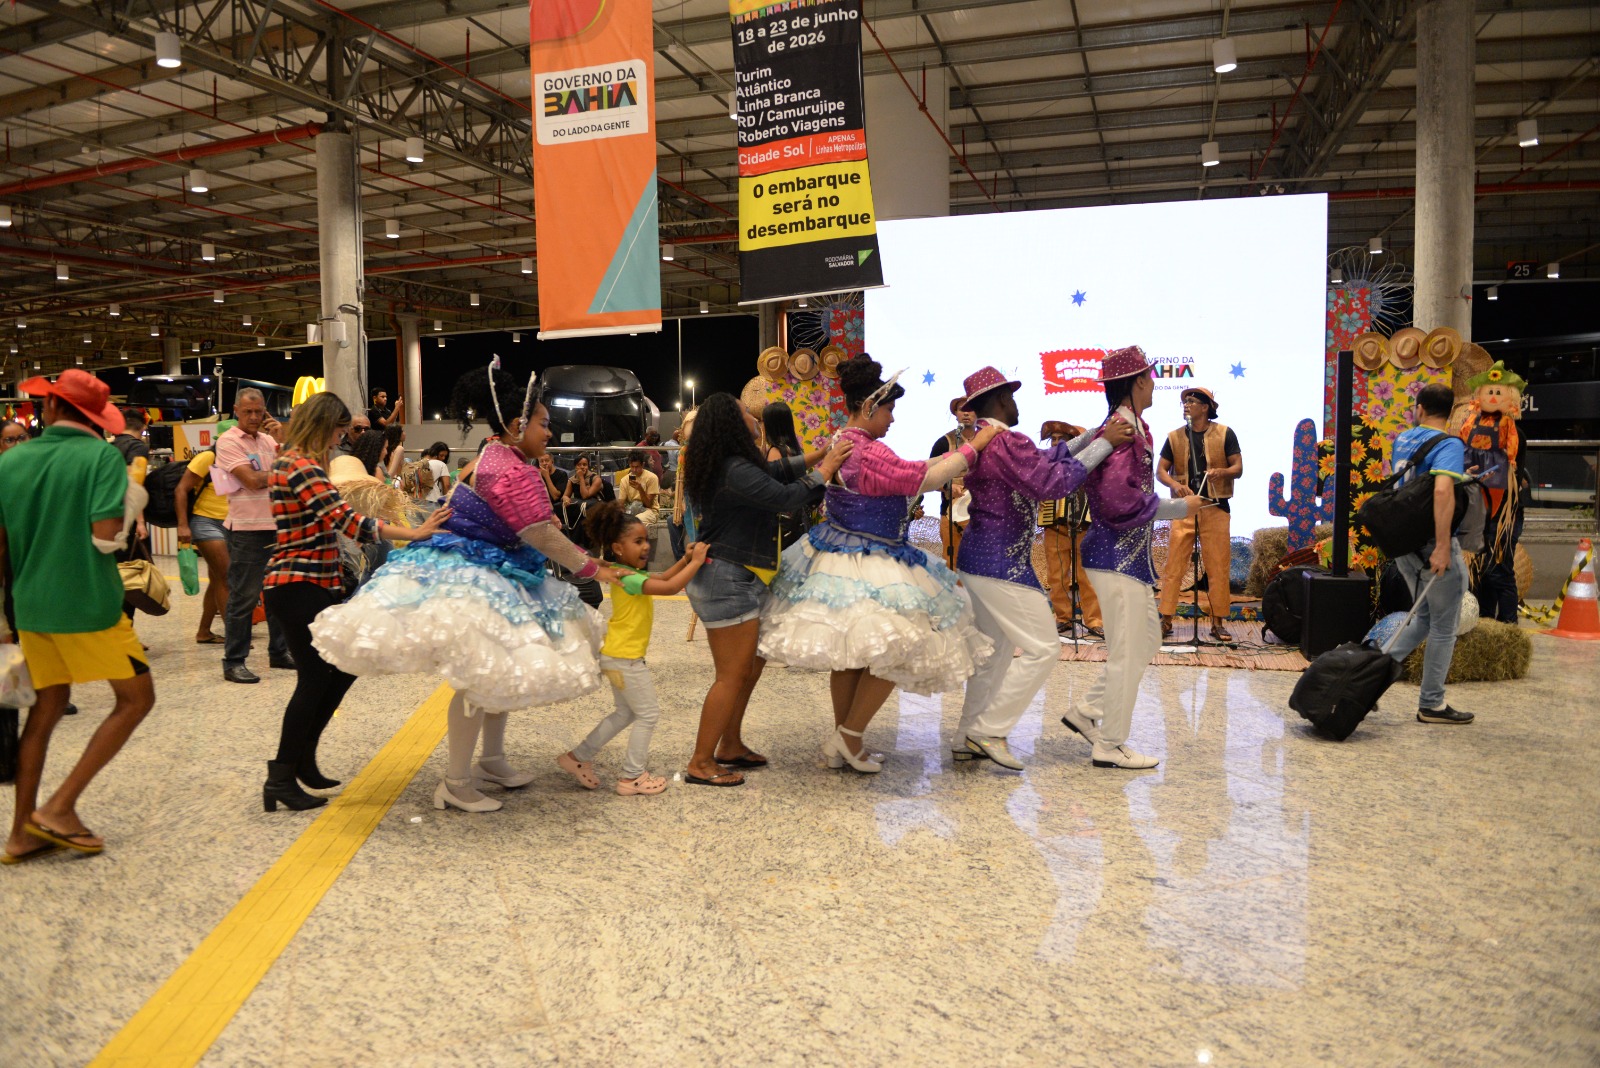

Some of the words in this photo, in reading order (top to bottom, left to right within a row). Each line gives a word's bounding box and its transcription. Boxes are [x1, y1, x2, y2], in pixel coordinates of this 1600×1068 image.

[738, 29, 755, 46] 18
[757, 27, 766, 36] a
[769, 19, 788, 37] 23
[791, 16, 810, 29] de
[813, 8, 858, 27] junho
[767, 40, 785, 54] de
[789, 31, 826, 48] 2026
[544, 71, 613, 92] GOVERNO
[616, 67, 636, 81] DA
[735, 66, 772, 84] Turim
[736, 77, 792, 98] Atlântico
[737, 98, 771, 113] Linha
[773, 87, 821, 105] Branca
[737, 115, 757, 128] RD
[758, 113, 765, 126] /
[767, 101, 845, 124] Camurujipe
[552, 128, 566, 138] DO
[567, 125, 590, 136] LADO
[591, 123, 603, 133] DA
[604, 120, 630, 131] GENTE
[738, 126, 789, 143] Roberto
[791, 115, 846, 137] Viagens
[827, 133, 856, 143] APENAS
[738, 149, 780, 165] Cidade
[784, 143, 805, 158] Sol
[816, 144, 833, 155] Linhas
[753, 184, 764, 199] O
[768, 172, 861, 197] embarque
[772, 194, 813, 215] será
[817, 194, 840, 209] no
[747, 210, 871, 240] desembarque
[828, 260, 854, 268] SALVADOR
[1514, 264, 1530, 277] 25
[1147, 356, 1180, 364] VERNO
[1181, 356, 1195, 364] DA
